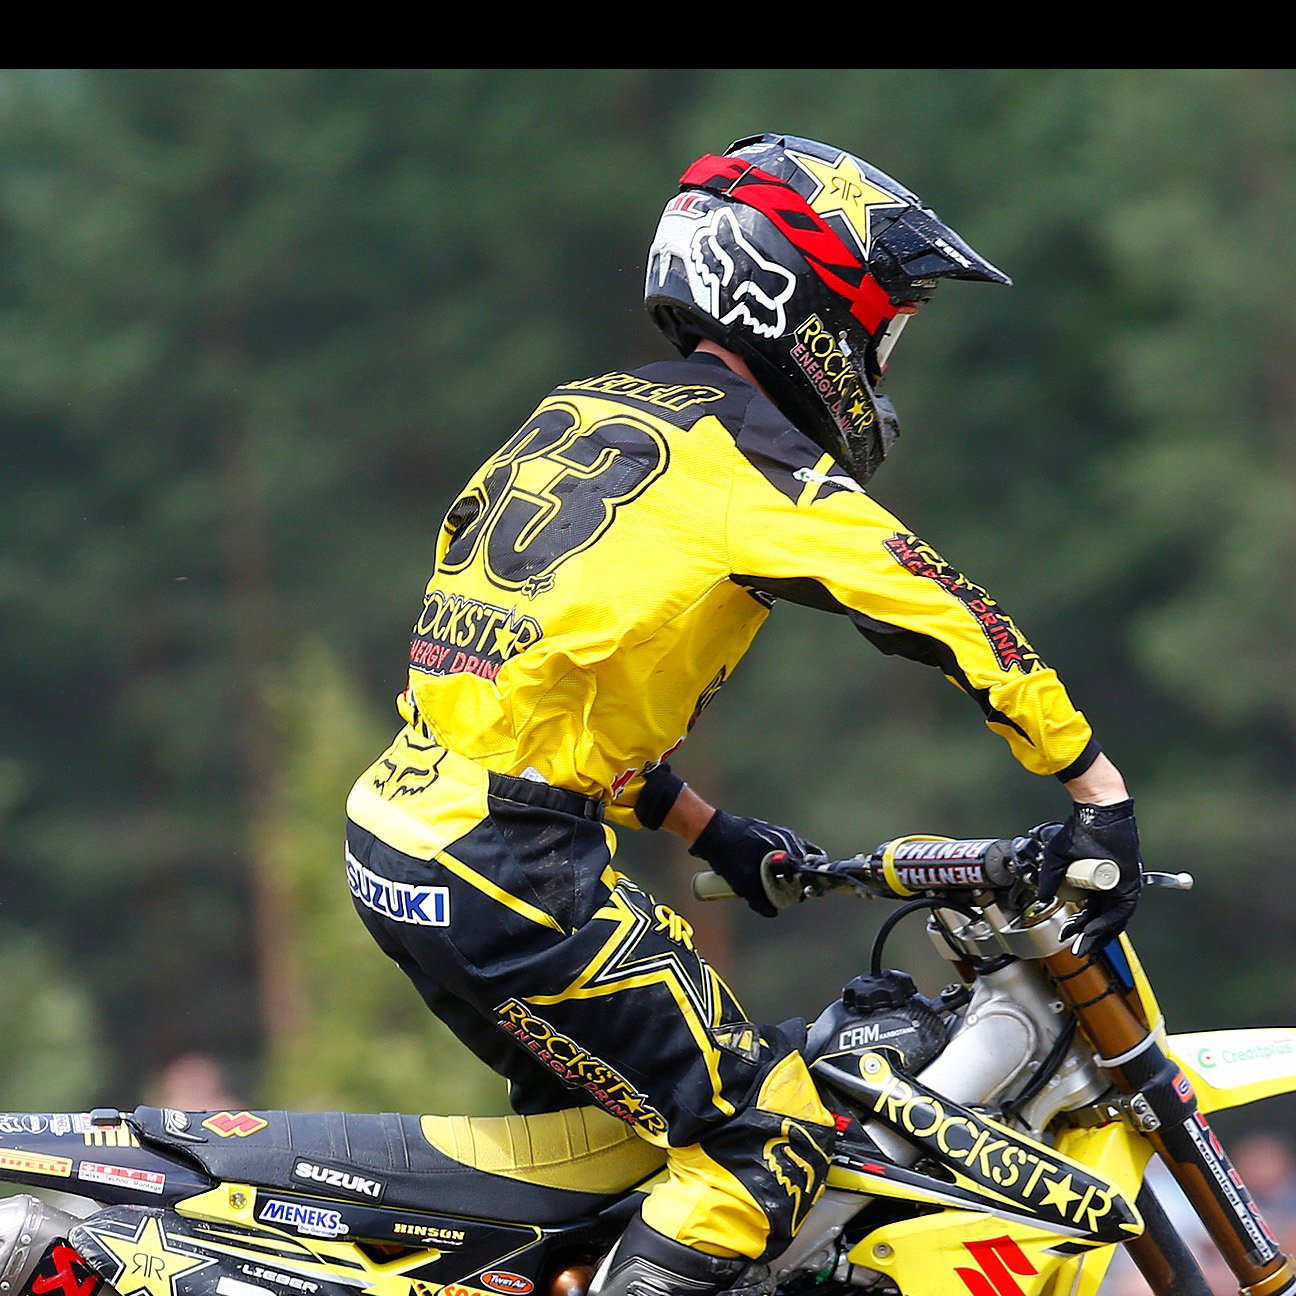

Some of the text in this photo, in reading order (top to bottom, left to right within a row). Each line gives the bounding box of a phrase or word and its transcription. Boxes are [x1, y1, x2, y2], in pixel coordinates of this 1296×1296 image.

[793, 344, 836, 399] ENERGY
[798, 317, 875, 434] ROCKTAR
[417, 594, 542, 661] OCKSTAR
[968, 599, 1023, 666] DRINK
[449, 651, 502, 680] DRIN
[892, 842, 989, 860] RENTHA
[347, 860, 445, 923] SUZUKI
[892, 865, 985, 885] RENTHA
[839, 1024, 880, 1050] CRM
[504, 1021, 639, 1124] ENERGY DRINK
[294, 1163, 383, 1199] SUZUKI
[1194, 1135, 1240, 1207] Technical
[1240, 1212, 1274, 1261] Touch
[263, 1203, 338, 1229] MENEKS
[393, 1223, 466, 1241] HINSON
[240, 1264, 319, 1294] LIEBER
[490, 1274, 527, 1289] Twin Air
